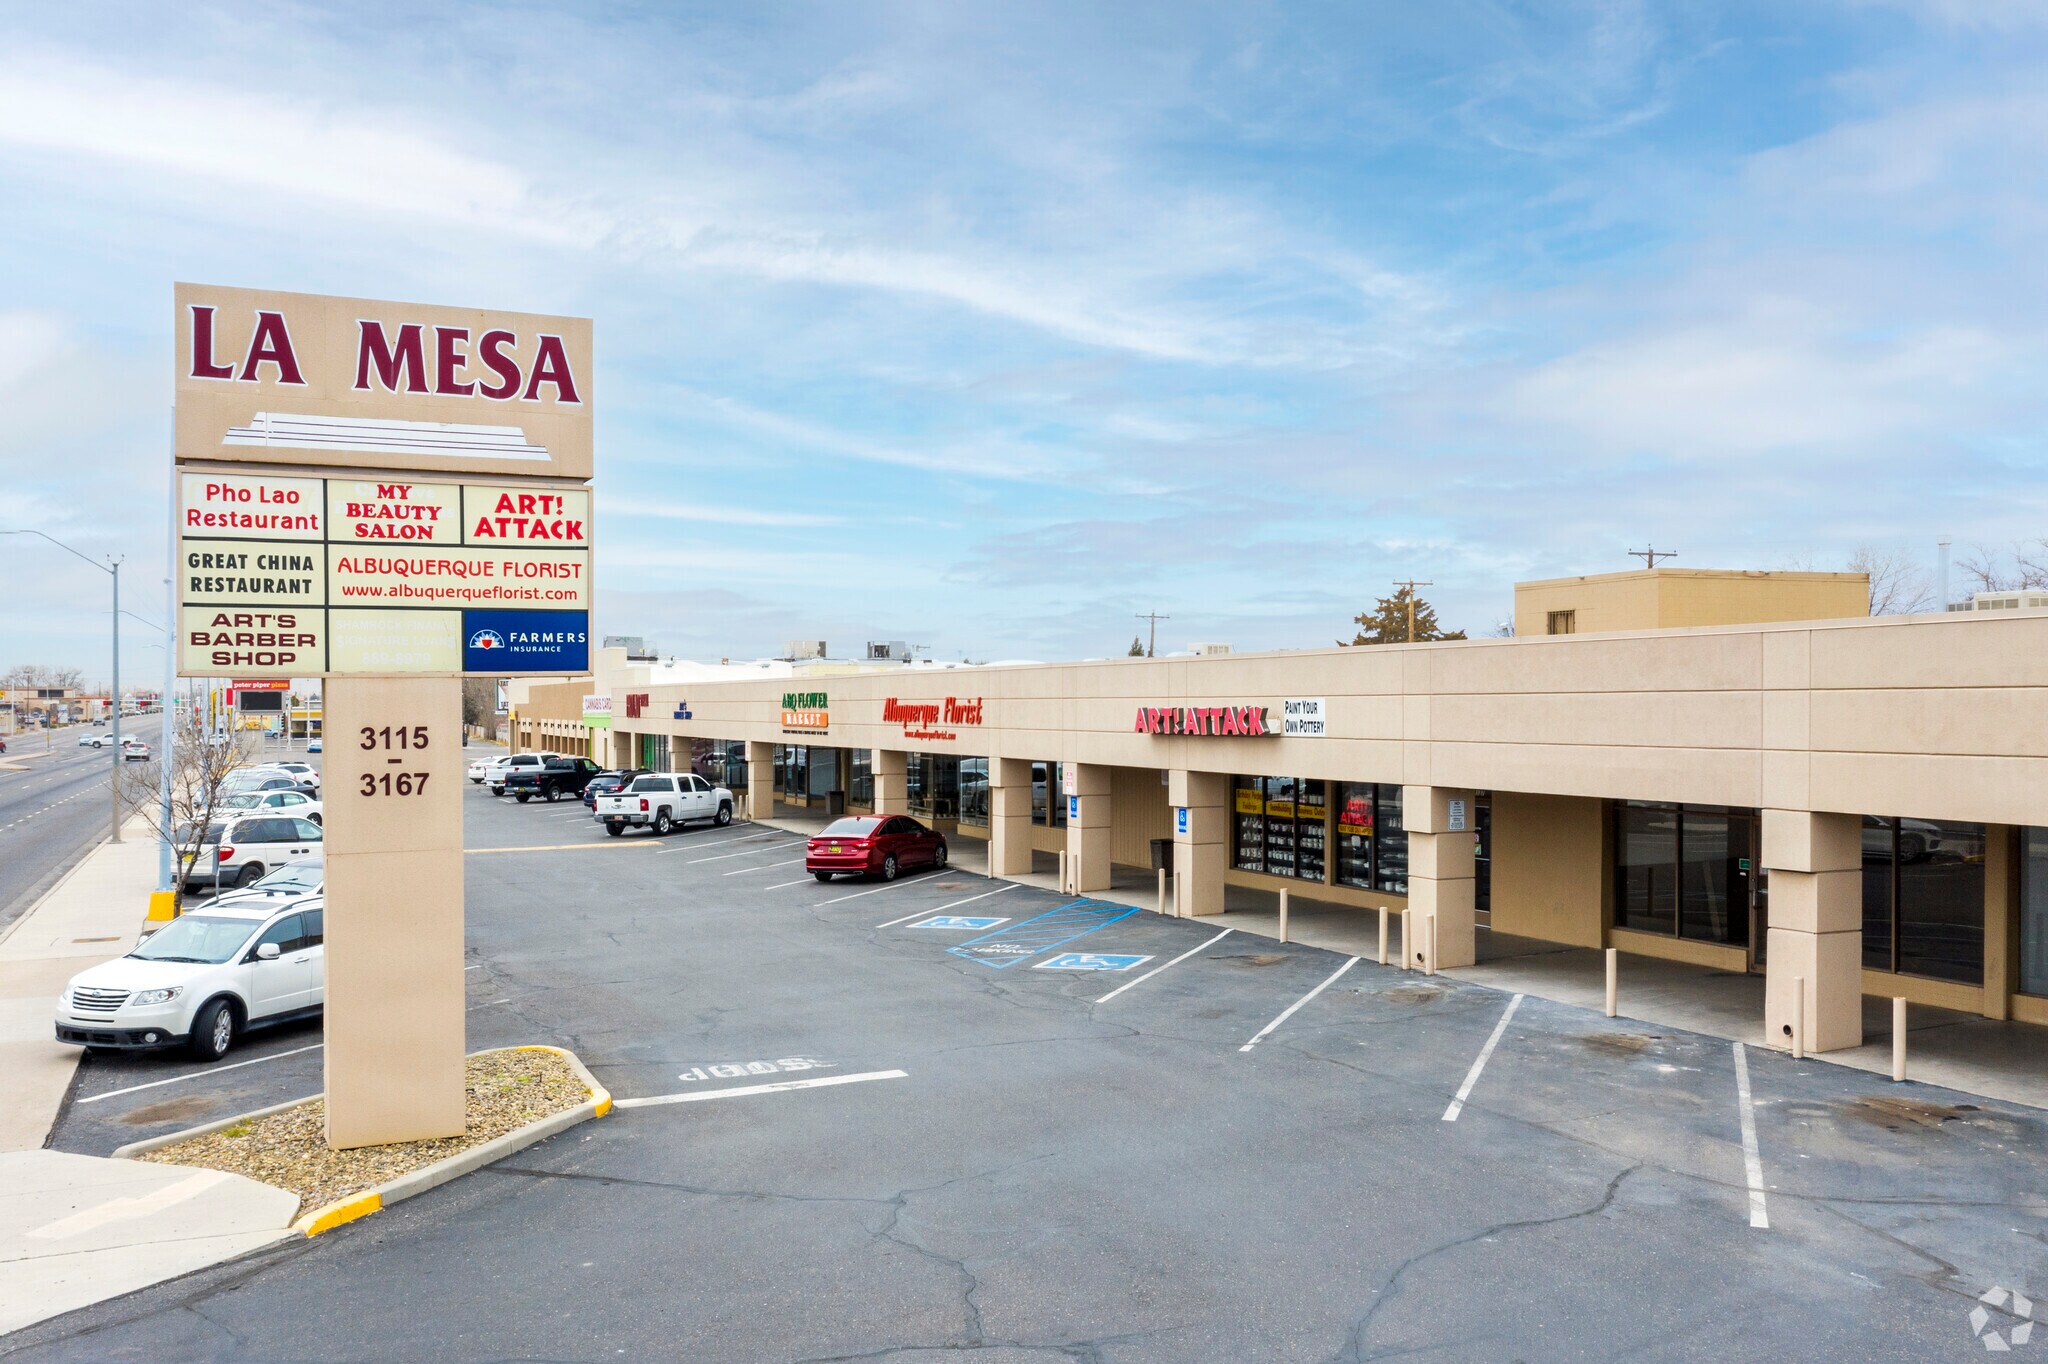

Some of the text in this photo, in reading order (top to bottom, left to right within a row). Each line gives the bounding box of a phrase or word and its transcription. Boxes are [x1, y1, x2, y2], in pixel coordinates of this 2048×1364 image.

[190, 305, 581, 404] LA MESA
[205, 483, 301, 506] Pho Lao
[377, 484, 412, 501] MY
[346, 502, 442, 521] BEAUTY
[494, 493, 564, 515] ART!
[186, 508, 319, 531] Restaurant
[474, 516, 584, 541] ATTACK
[354, 522, 434, 541] SALON
[188, 552, 314, 571] GREAT CHINA
[338, 556, 582, 579] ALBUQUERQUE FLORIST
[190, 576, 312, 594] RESTAURANT
[341, 583, 577, 603] www.albuquerqueflorist.com
[211, 613, 297, 629] ART'S
[190, 631, 316, 648] BARBER
[510, 632, 586, 643] FARMERS
[211, 651, 296, 666] SHOP
[510, 645, 561, 653] INSURANCE
[234, 681, 252, 689] peter
[782, 692, 828, 711] ABQ FLOWER
[1284, 700, 1318, 715] PAINT YOUR
[786, 713, 821, 725] MARKET
[883, 696, 983, 729] Albuquerque Florist
[1285, 719, 1325, 734] OWN POTTERY
[359, 725, 429, 751] 3115
[359, 772, 430, 797] 3167
